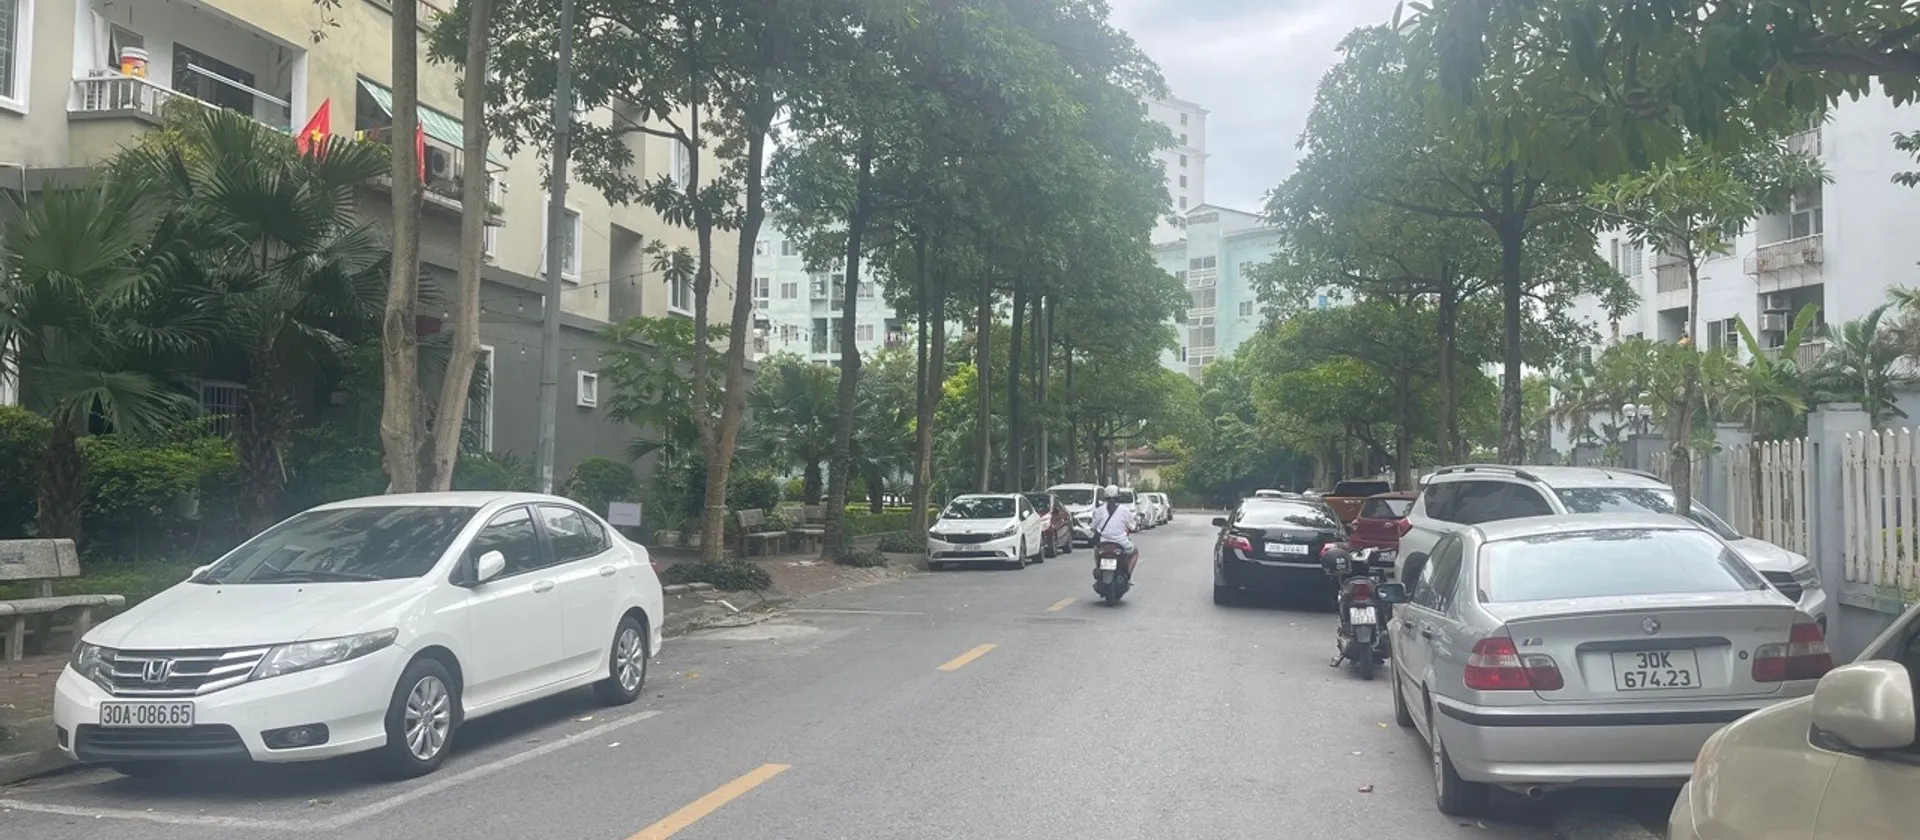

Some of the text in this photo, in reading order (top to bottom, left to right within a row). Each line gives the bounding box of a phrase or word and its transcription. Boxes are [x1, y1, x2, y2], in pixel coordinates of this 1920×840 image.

[1636, 651, 1673, 669] 30K
[1624, 669, 1691, 688] 674.23
[103, 704, 191, 724] 30A-086.65
